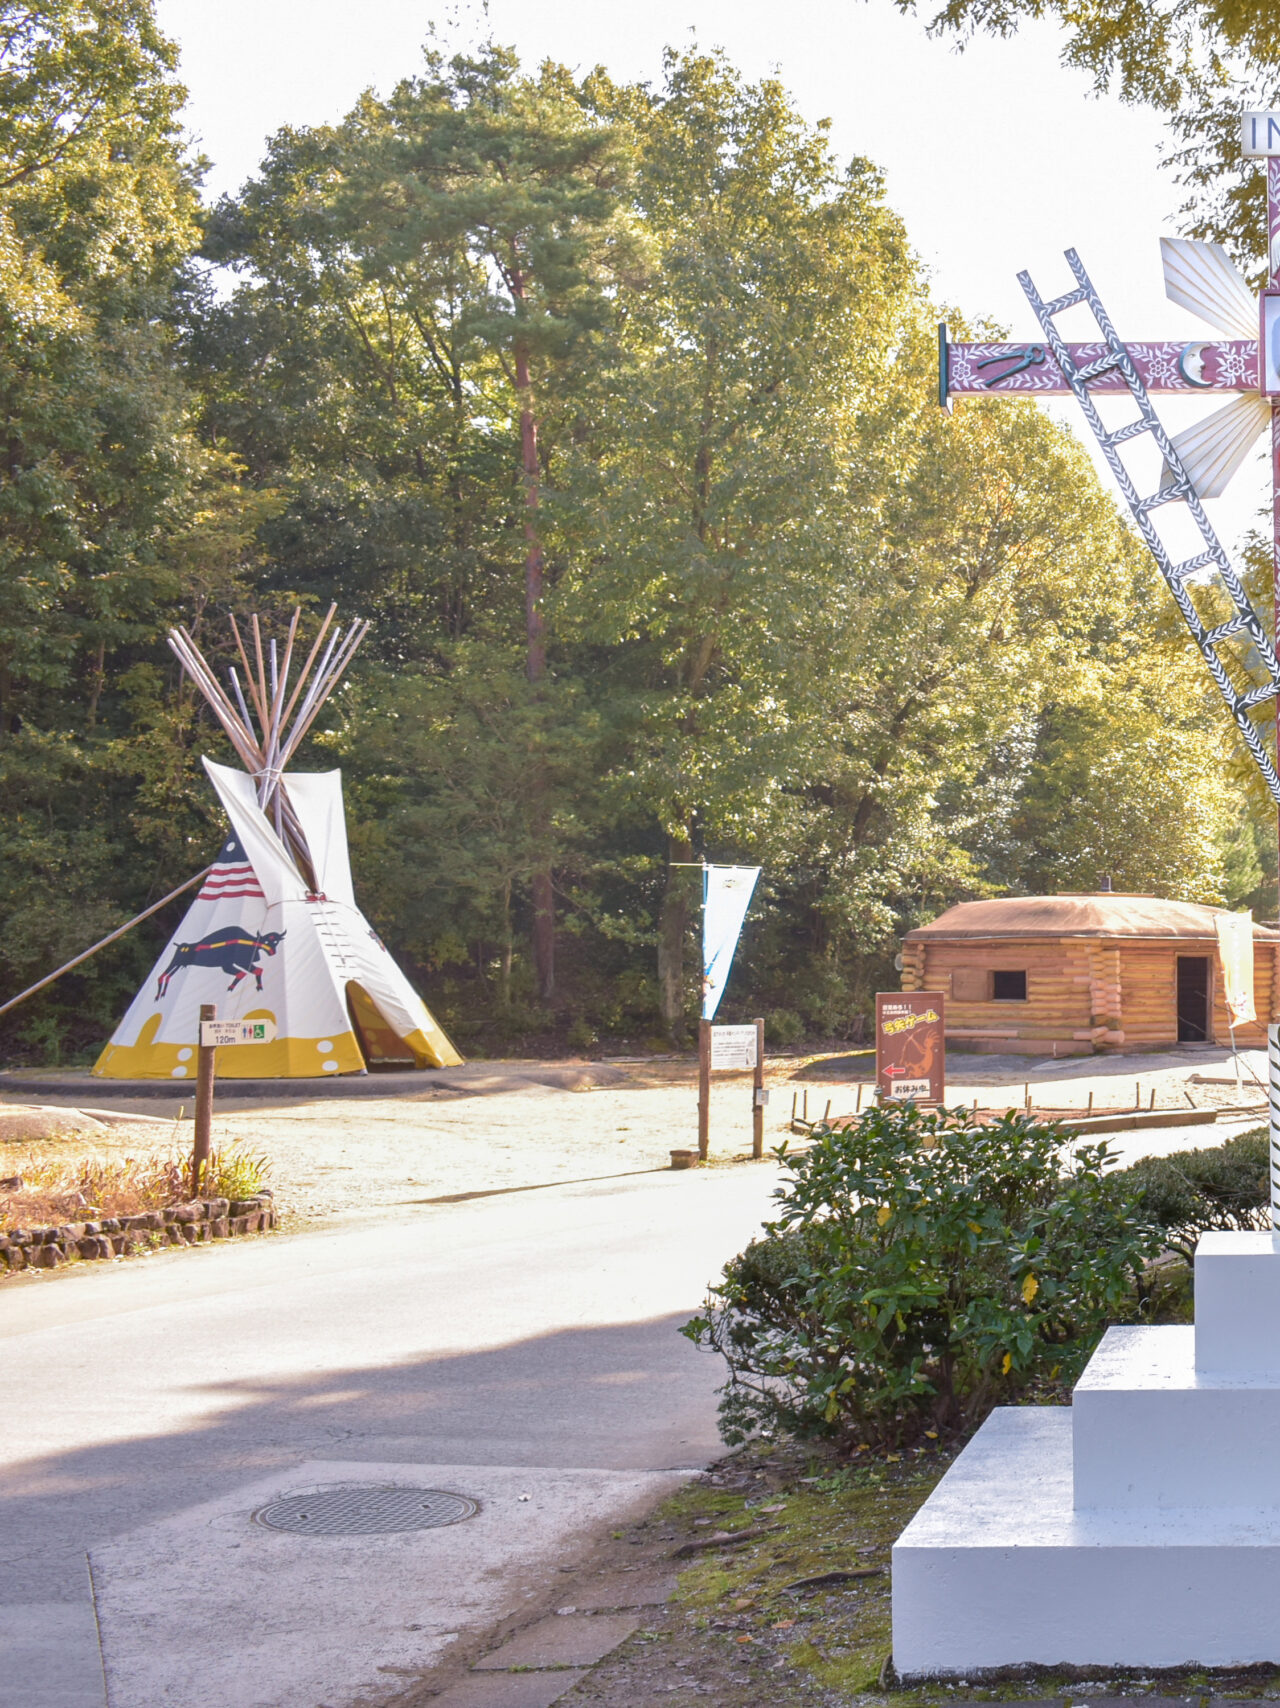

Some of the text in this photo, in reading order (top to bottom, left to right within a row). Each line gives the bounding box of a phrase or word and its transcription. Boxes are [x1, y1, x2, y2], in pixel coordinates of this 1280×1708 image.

[881, 1009, 940, 1036] 弓矢ゲーム
[216, 1035, 236, 1044] 120m
